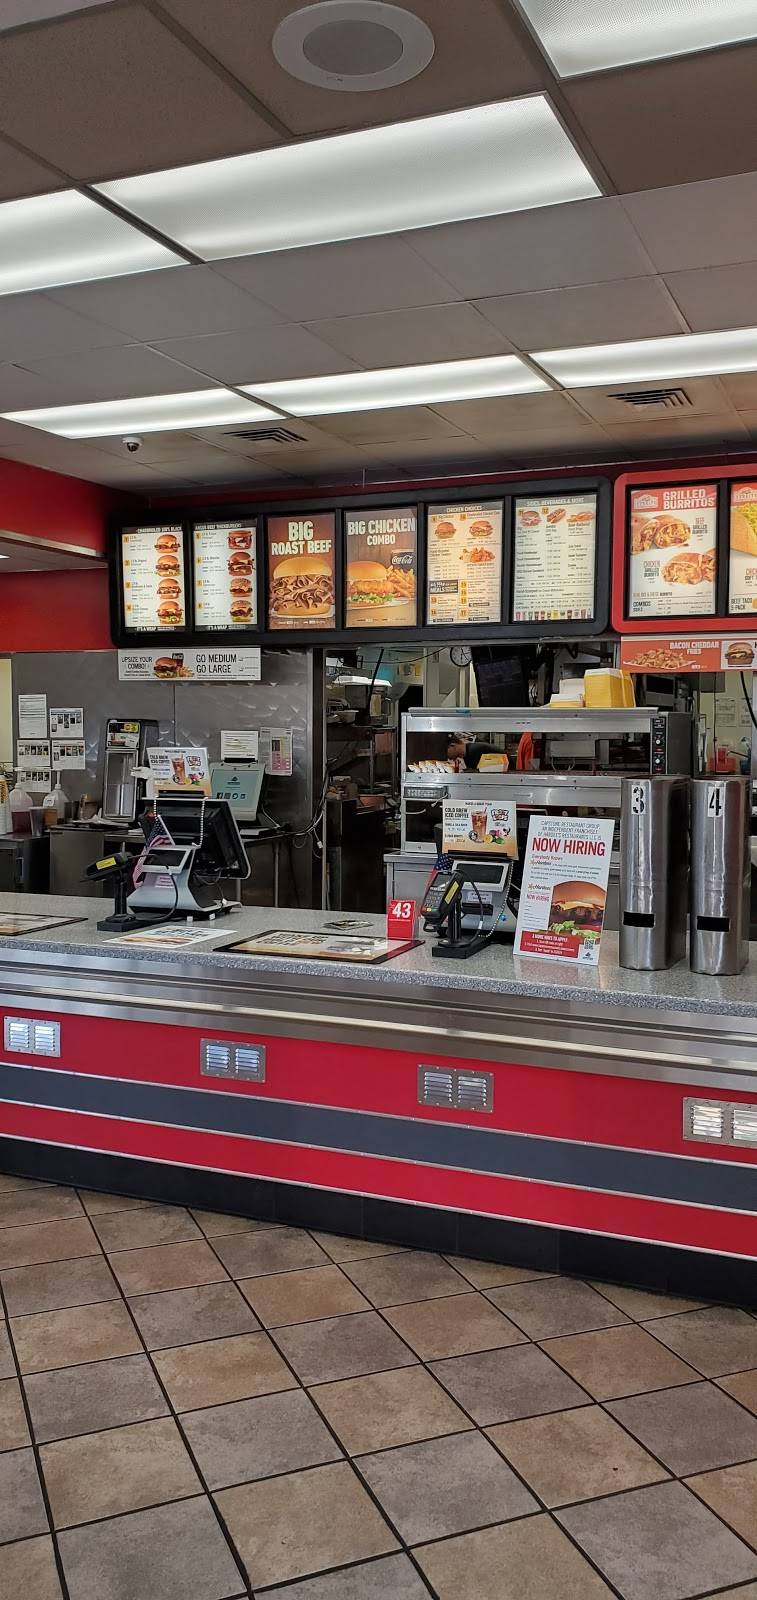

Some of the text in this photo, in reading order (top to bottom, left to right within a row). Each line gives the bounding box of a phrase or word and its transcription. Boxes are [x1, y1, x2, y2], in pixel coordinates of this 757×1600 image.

[663, 489, 705, 500] GRILLED
[663, 497, 714, 509] BURRITOS
[288, 520, 314, 541] BIG
[347, 518, 416, 535] BIG CHICKEN
[367, 534, 395, 546] COMBO
[271, 539, 332, 556] ROAST BEEF
[691, 641, 719, 649] CHEDDAR
[196, 654, 237, 663] GO MEDIUM
[196, 664, 231, 673] GO LARGE
[633, 786, 645, 813] 3
[709, 788, 722, 816] 4
[532, 837, 606, 856] NOW HIRING
[536, 894, 549, 902] HIRING
[392, 902, 411, 919] 43
